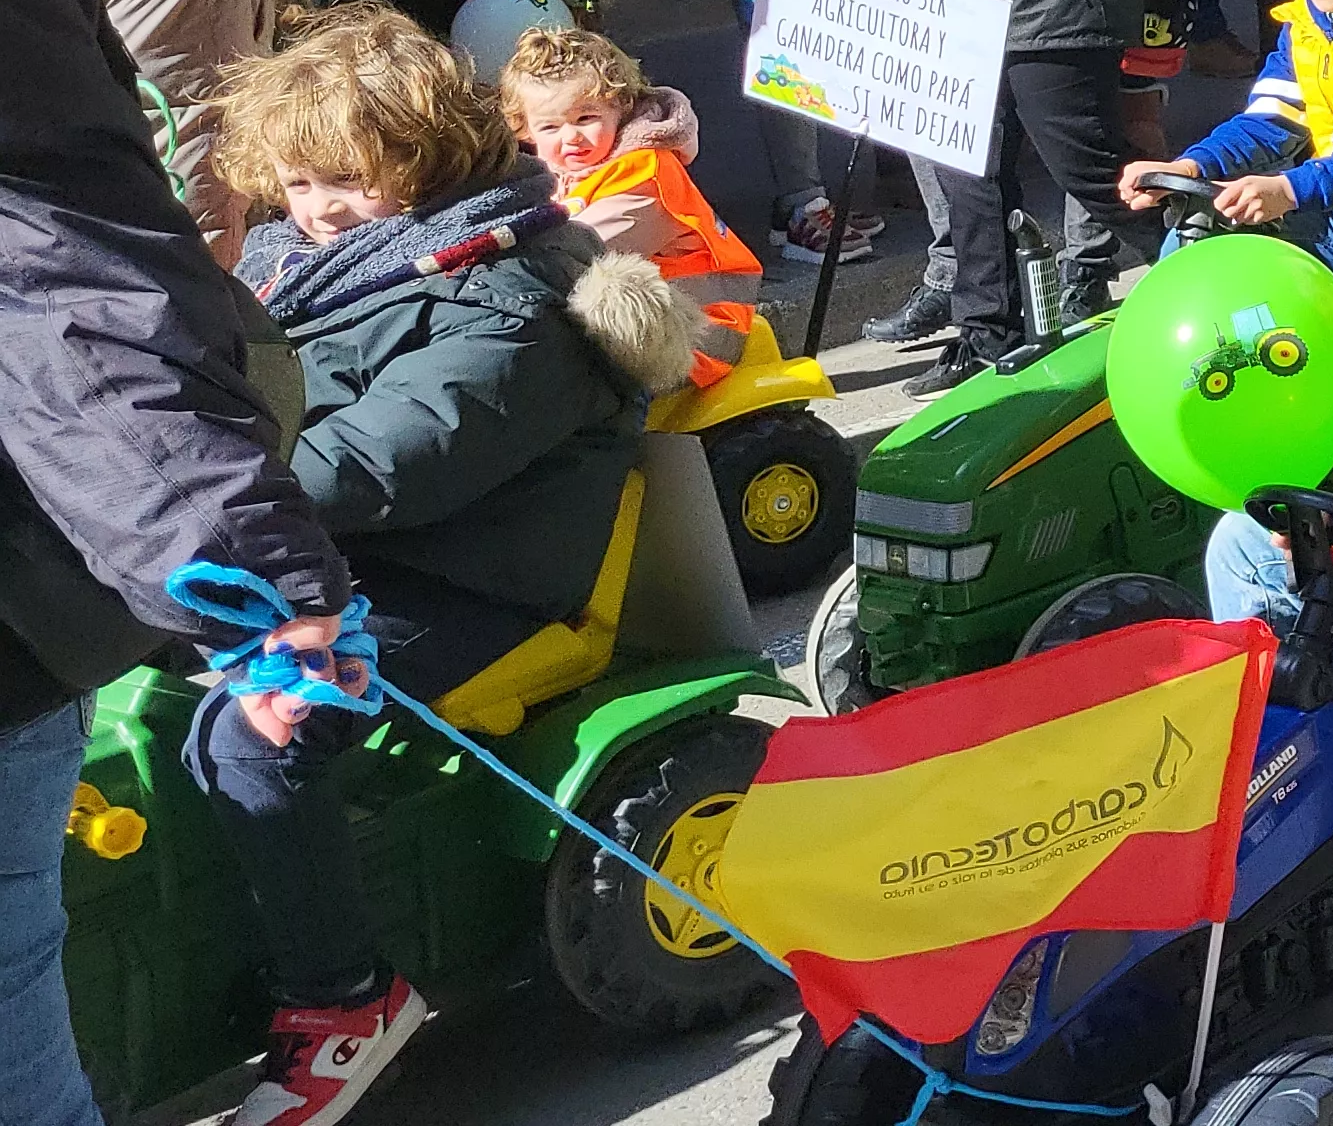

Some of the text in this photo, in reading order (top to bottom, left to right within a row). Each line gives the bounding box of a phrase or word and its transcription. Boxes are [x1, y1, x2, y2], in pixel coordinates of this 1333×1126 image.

[776, 18, 975, 110] GANADERA COMO PAPÁ
[936, 29, 947, 59] Y
[880, 94, 906, 131] ME
[915, 107, 977, 154] DEJAN
